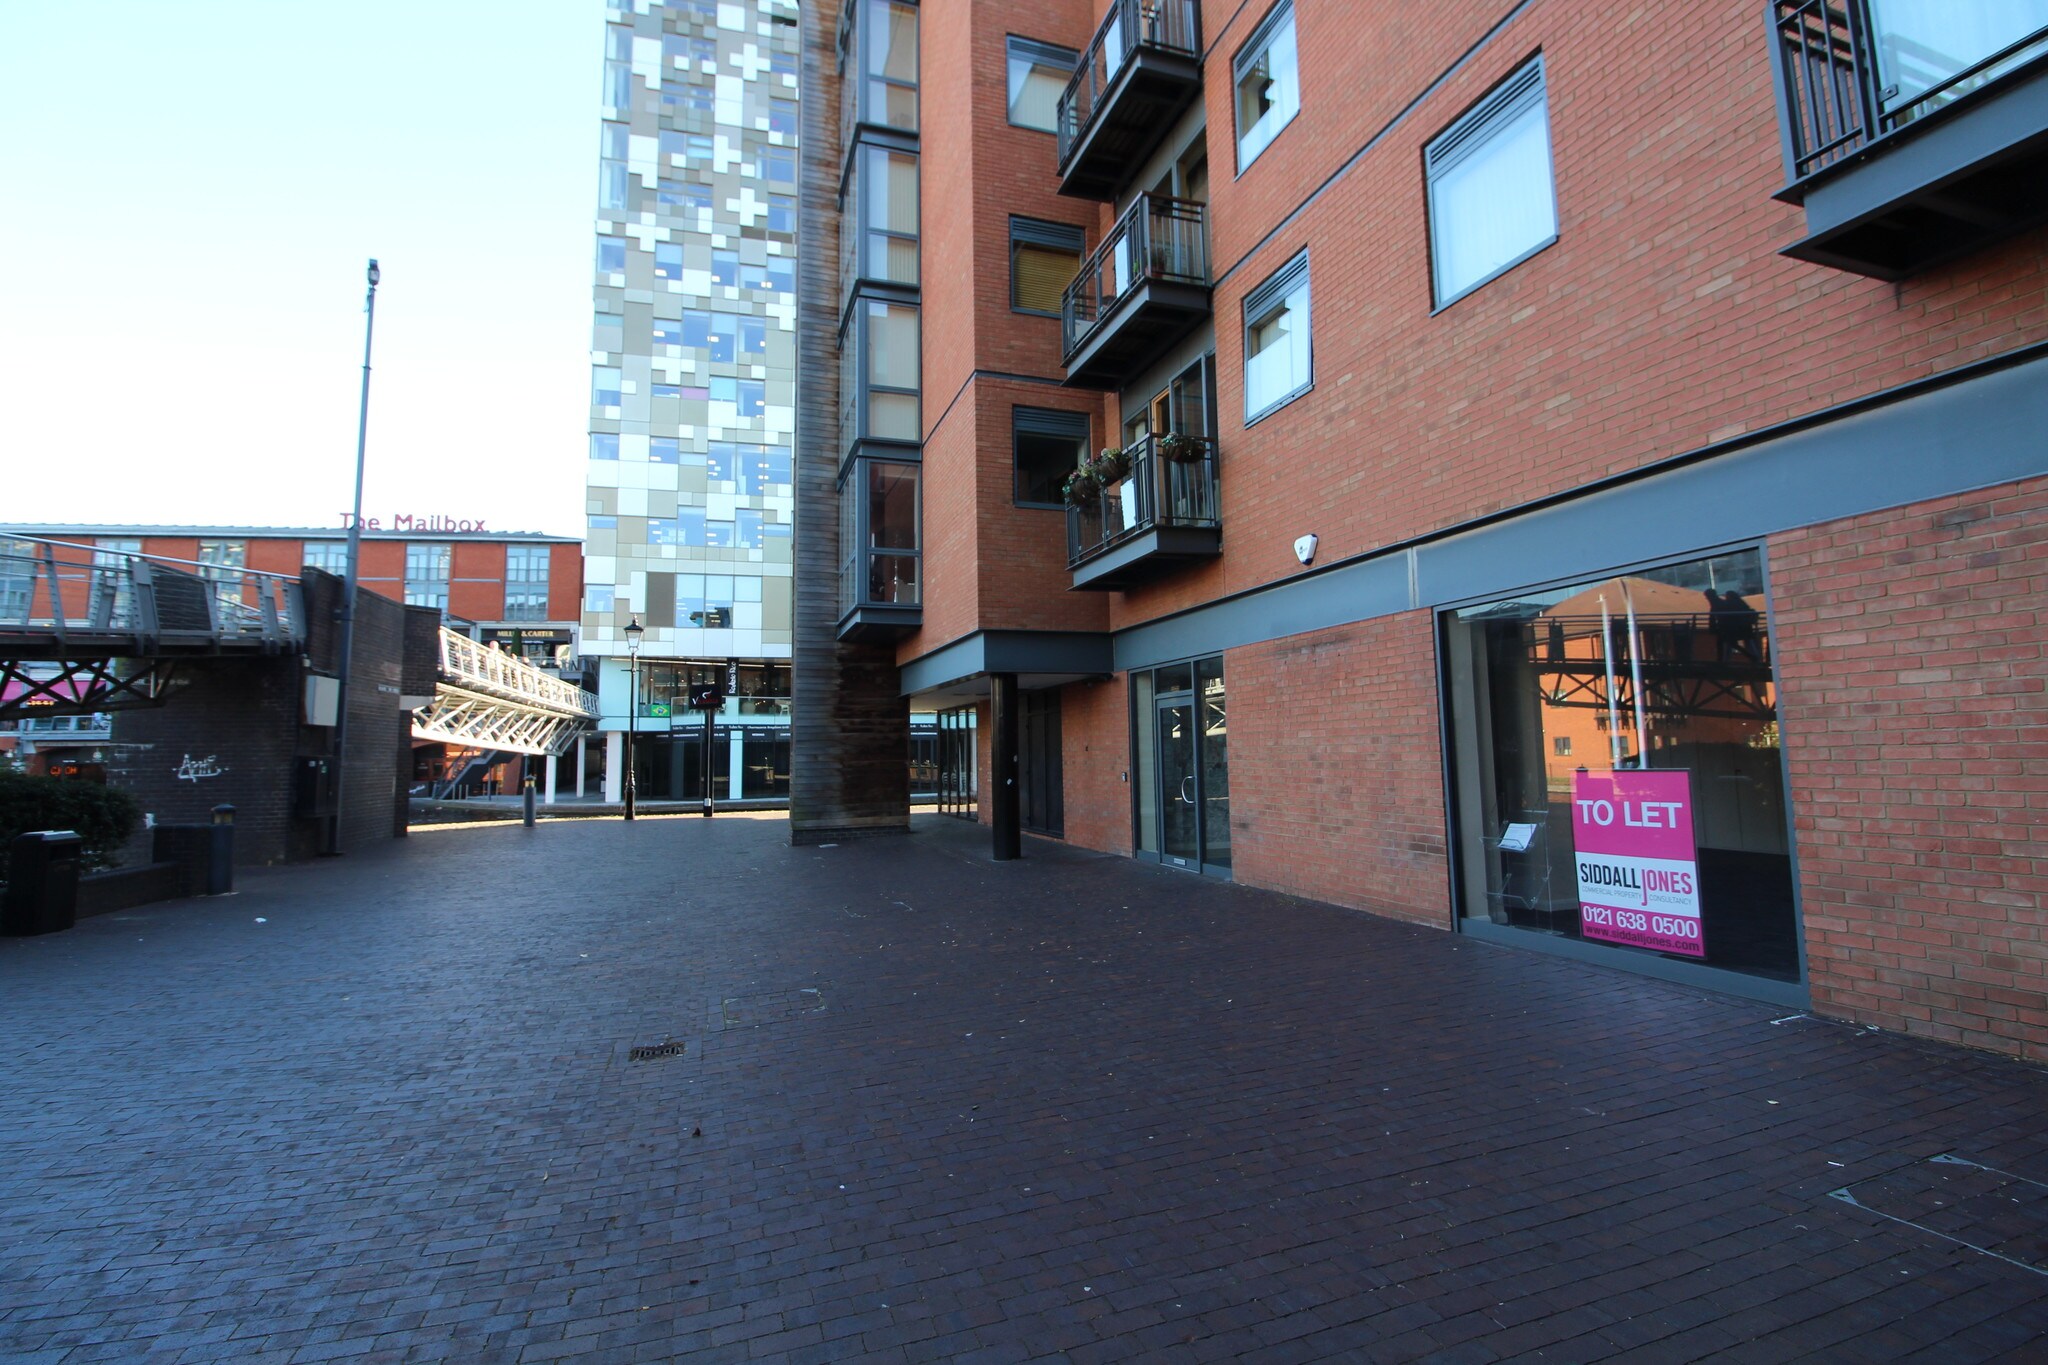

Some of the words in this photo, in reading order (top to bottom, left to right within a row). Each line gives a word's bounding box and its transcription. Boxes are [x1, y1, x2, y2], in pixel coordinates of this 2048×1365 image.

[394, 513, 486, 532] Mailbox
[1576, 799, 1614, 826] TO
[1623, 801, 1683, 829] LET
[1580, 862, 1642, 889] SIDDALL
[1641, 868, 1693, 906] JONES
[1581, 885, 1613, 896] COMMERCIAL
[1613, 889, 1642, 899] PROPERTY
[1648, 894, 1692, 905] CONSULTANCY
[1583, 905, 1613, 926] 0121
[1616, 910, 1647, 931] 638
[1652, 915, 1698, 939] 0500
[1585, 925, 1700, 952] www.siddalljones.com
